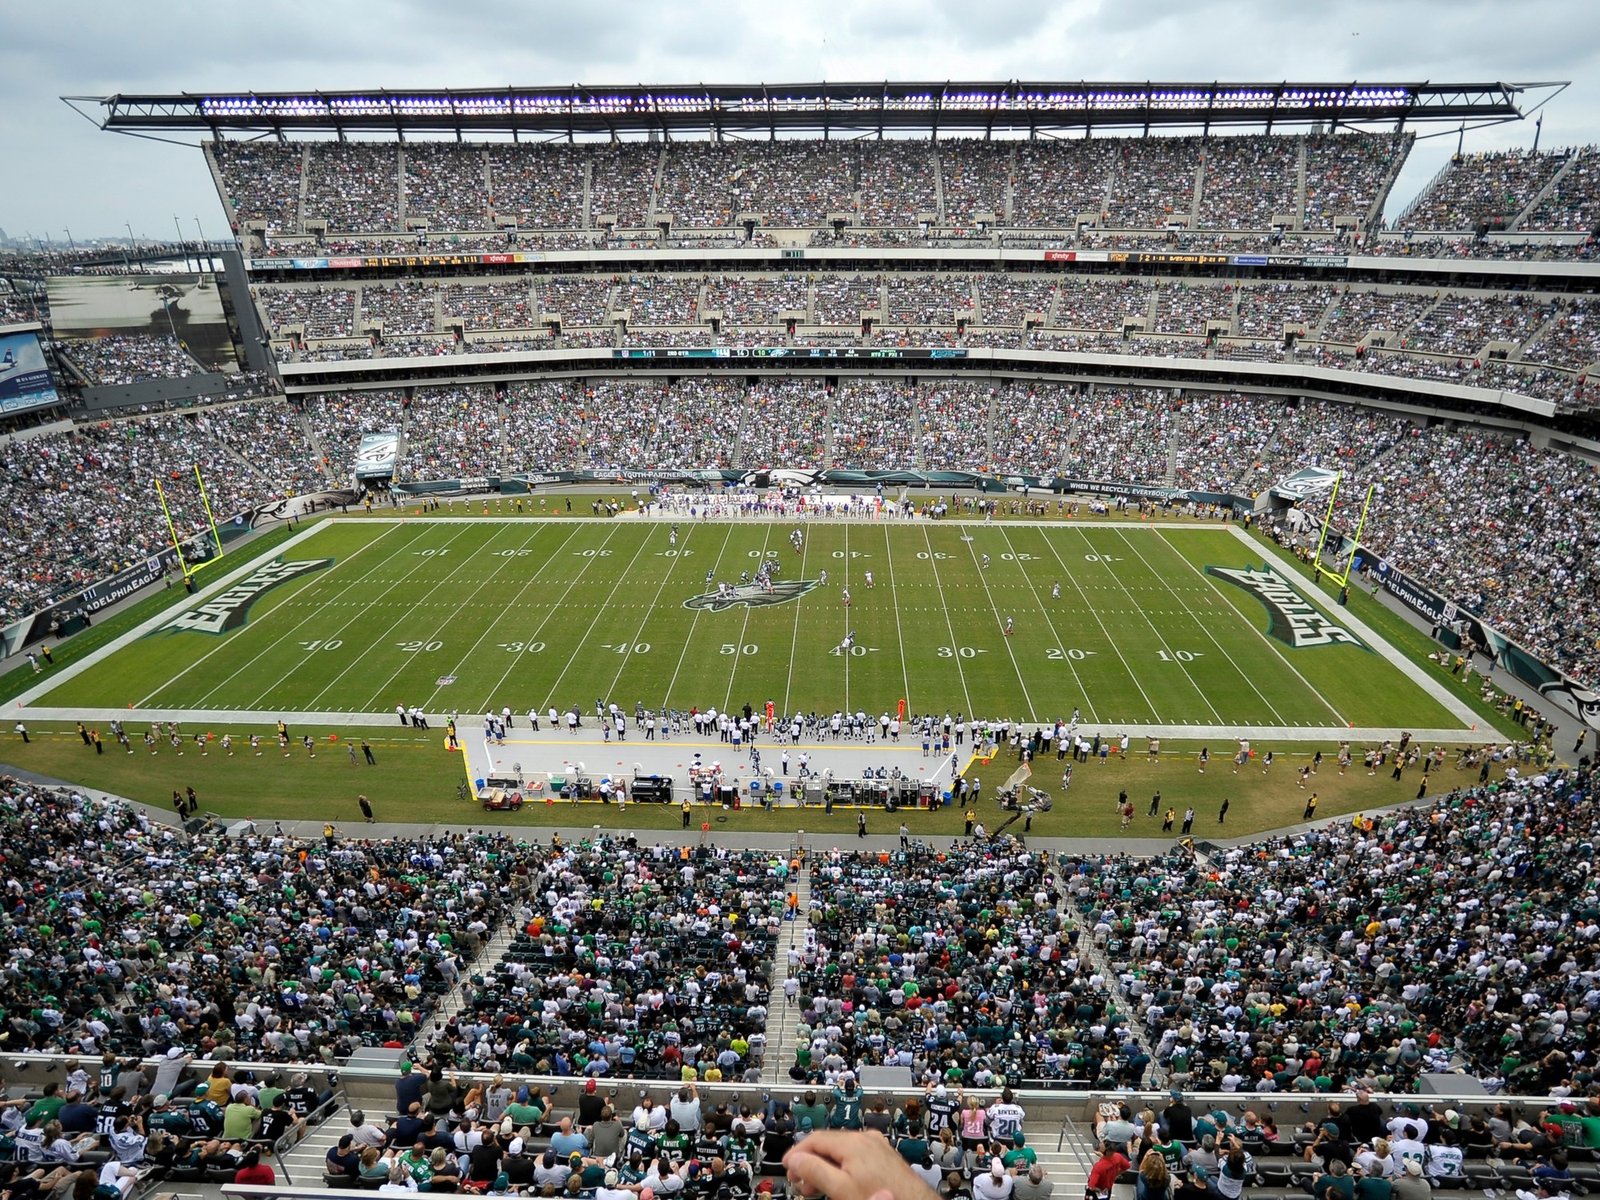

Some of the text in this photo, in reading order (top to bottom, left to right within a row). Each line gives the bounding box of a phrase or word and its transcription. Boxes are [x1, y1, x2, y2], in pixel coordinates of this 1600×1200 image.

[593, 471, 620, 479] EAGLES
[622, 471, 647, 479] YOUTH
[648, 471, 698, 479] PARTNERSHIP
[1070, 482, 1089, 490] WHEN
[1101, 485, 1131, 494] RECYCLE,
[1132, 488, 1169, 498] EVERYBODY
[421, 549, 451, 557] 10
[499, 549, 532, 557] 20
[582, 549, 613, 557] 30
[748, 550, 779, 558] 50
[916, 551, 947, 560] 30
[1000, 552, 1031, 560] 20
[158, 558, 330, 633] EAGLES
[1212, 567, 1364, 647] EAGLES
[303, 639, 343, 652] 10
[400, 640, 444, 653] 20
[506, 640, 547, 654] 30
[611, 642, 651, 654] 40
[719, 643, 759, 656] 50
[828, 644, 867, 657] 40
[937, 645, 976, 658] 30
[1046, 648, 1086, 660] 20
[1155, 649, 1194, 662] 10
[844, 1104, 851, 1120] 1
[95, 1115, 117, 1134] 58
[929, 1114, 950, 1131] 24
[966, 1120, 981, 1134] 21
[999, 1119, 1017, 1136] 20
[262, 1124, 269, 1136] 7
[416, 1163, 429, 1176] 99
[1442, 1162, 1456, 1176] 7
